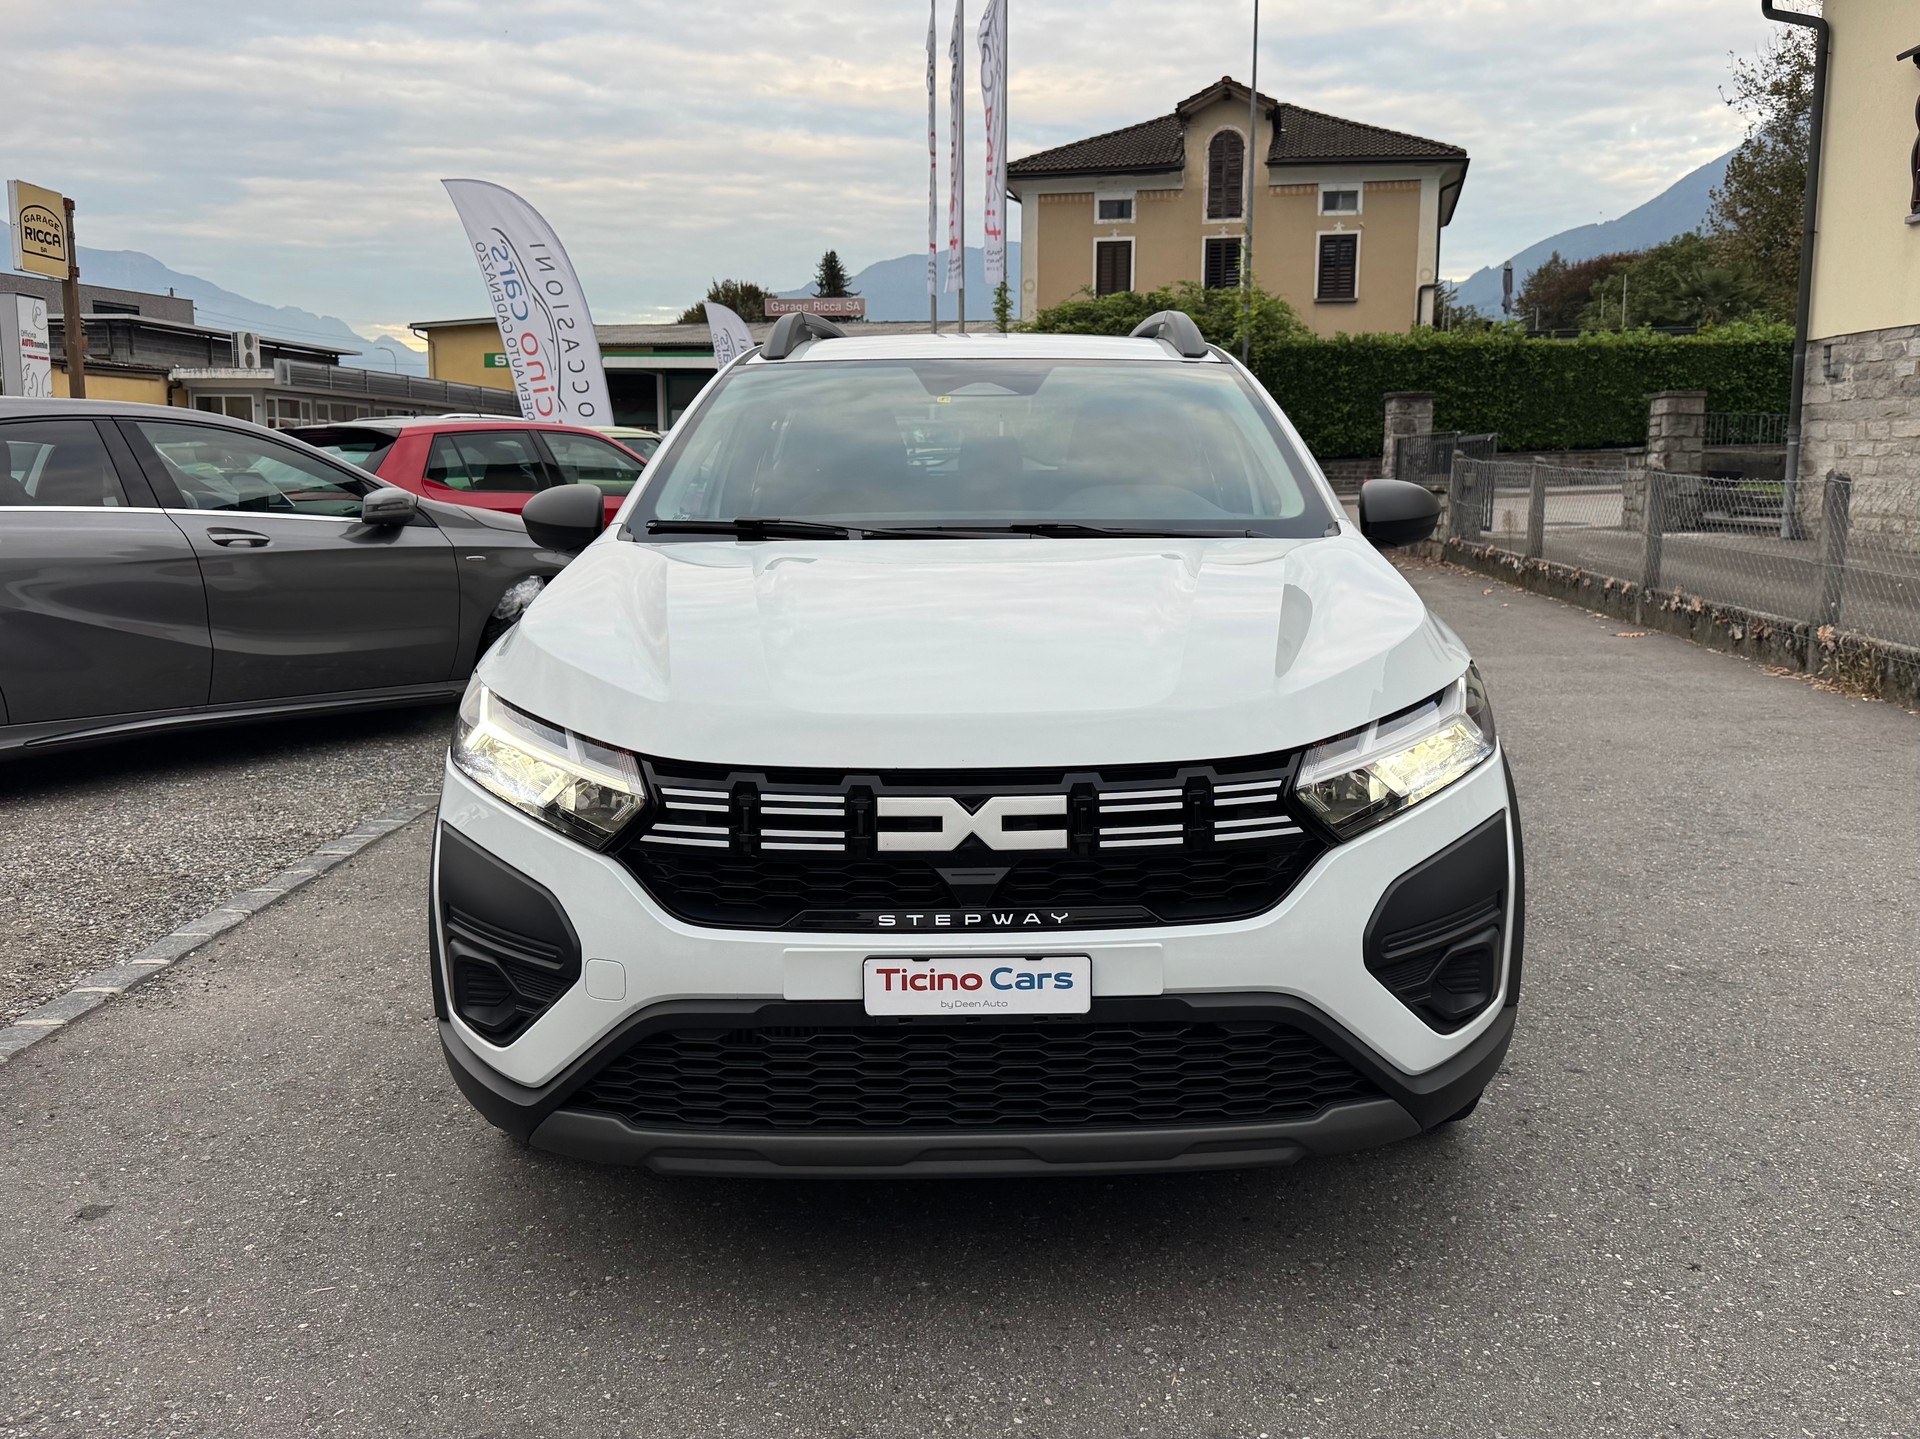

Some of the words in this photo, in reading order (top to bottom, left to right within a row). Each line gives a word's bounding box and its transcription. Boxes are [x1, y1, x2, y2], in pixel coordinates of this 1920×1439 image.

[23, 214, 60, 232] GARAGE
[24, 226, 61, 248] RICCA
[771, 301, 809, 312] Garage
[813, 301, 842, 311] Ricca
[845, 301, 861, 311] SA
[878, 912, 1069, 927] STEPWAY
[876, 968, 983, 992] Ticino
[990, 967, 1074, 991] Cars
[940, 999, 954, 1009] by
[955, 1000, 981, 1008] Deen
[982, 999, 1008, 1008] Auto
